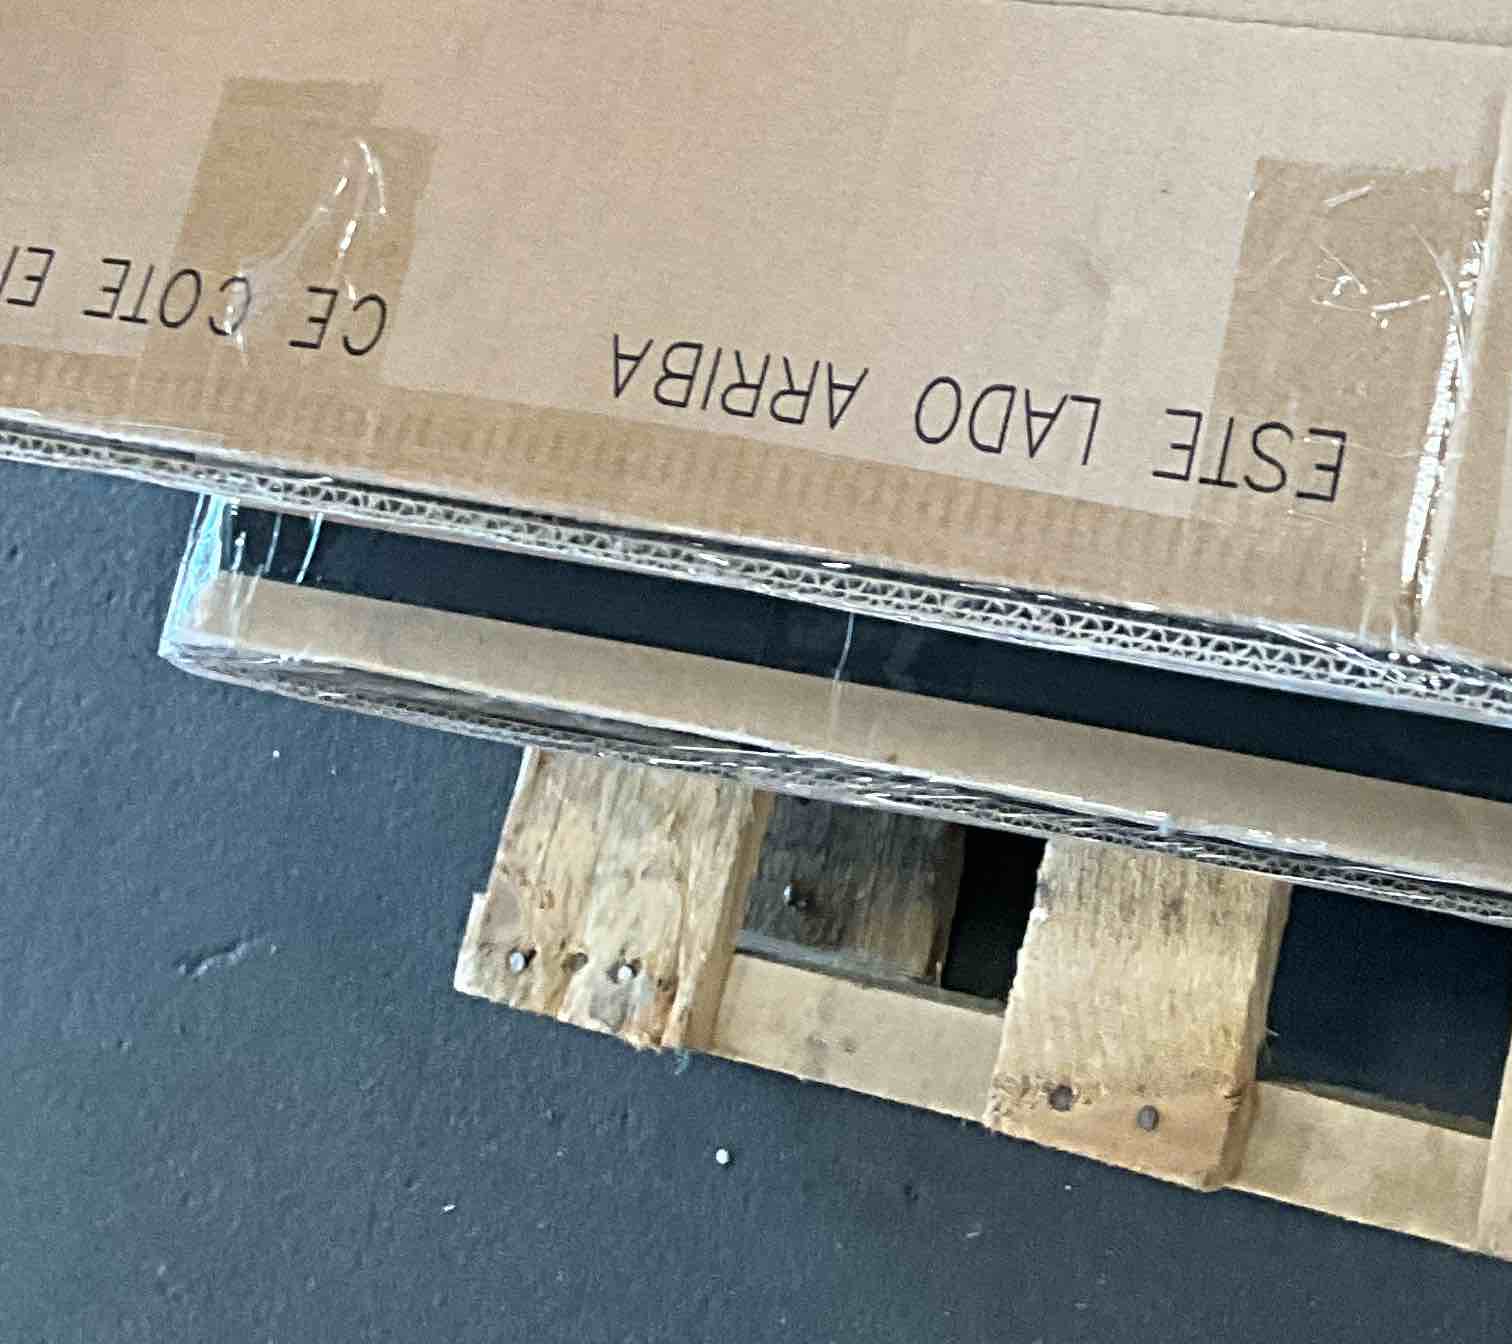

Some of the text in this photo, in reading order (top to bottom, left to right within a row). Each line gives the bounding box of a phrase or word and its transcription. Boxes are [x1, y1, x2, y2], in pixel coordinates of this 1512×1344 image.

[0, 245, 388, 355] CE COTE E
[612, 333, 1348, 502] ESTE LADO ARRIBA
